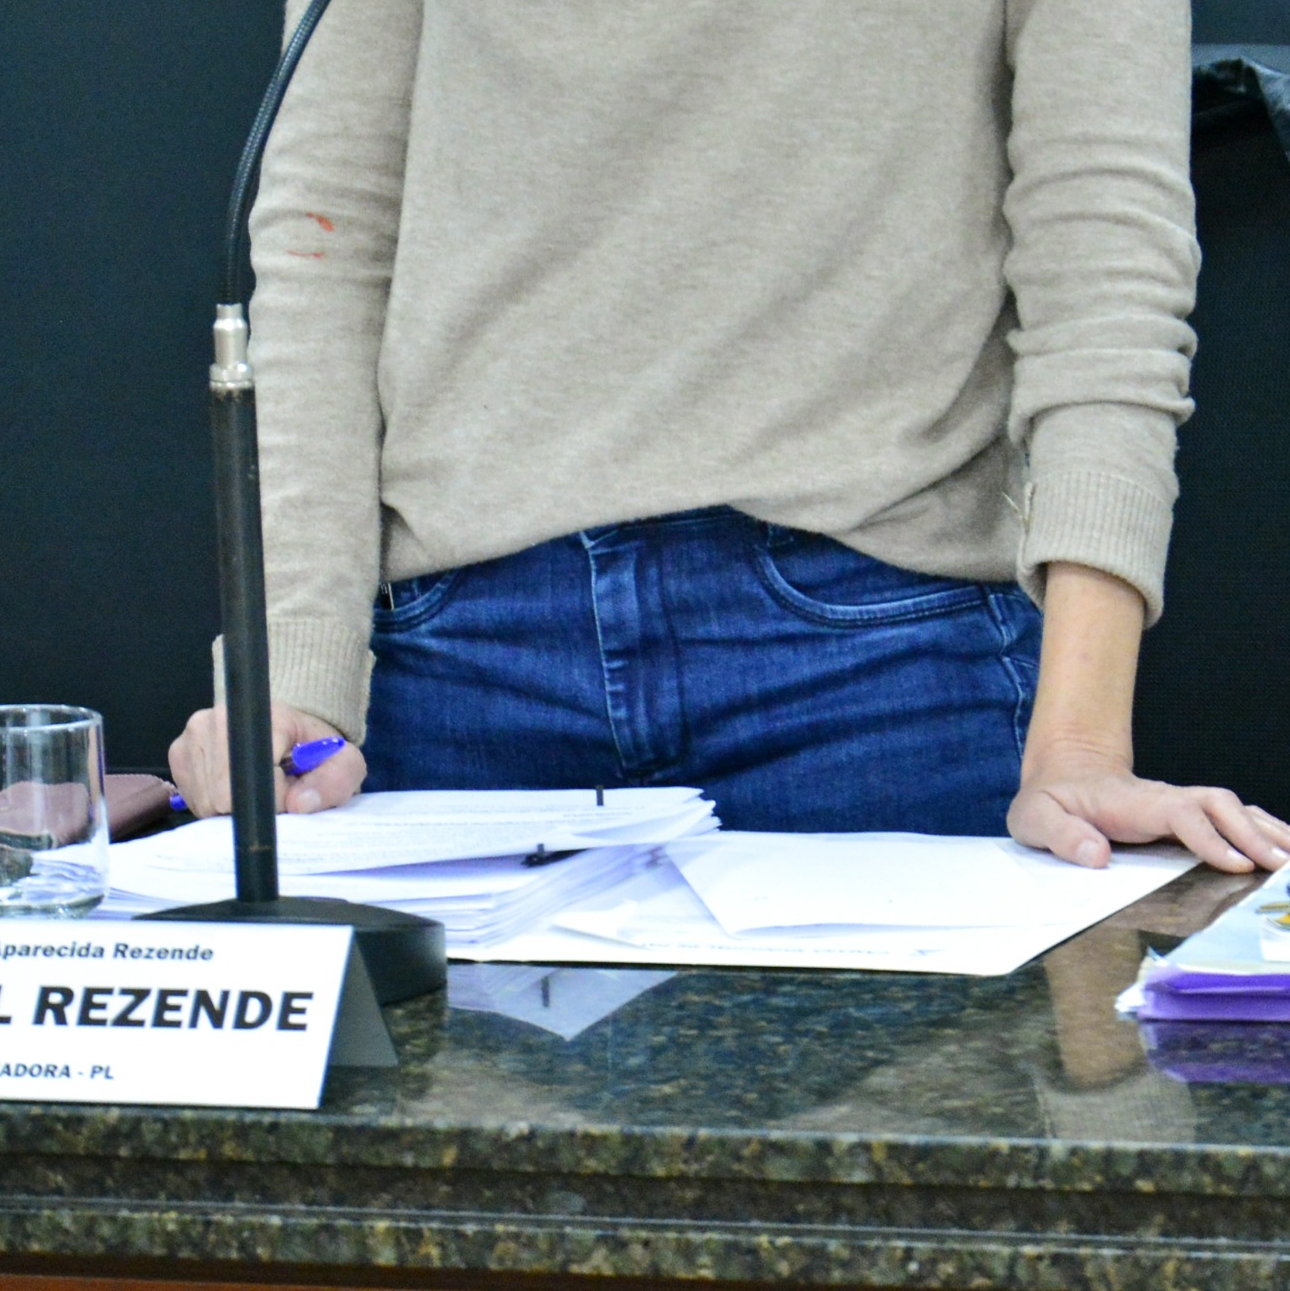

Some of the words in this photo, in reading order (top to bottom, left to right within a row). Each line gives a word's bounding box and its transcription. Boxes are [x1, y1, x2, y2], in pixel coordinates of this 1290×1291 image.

[112, 942, 214, 961] Rezende
[31, 984, 314, 1031] REZENDE
[90, 1065, 115, 1081] PL
